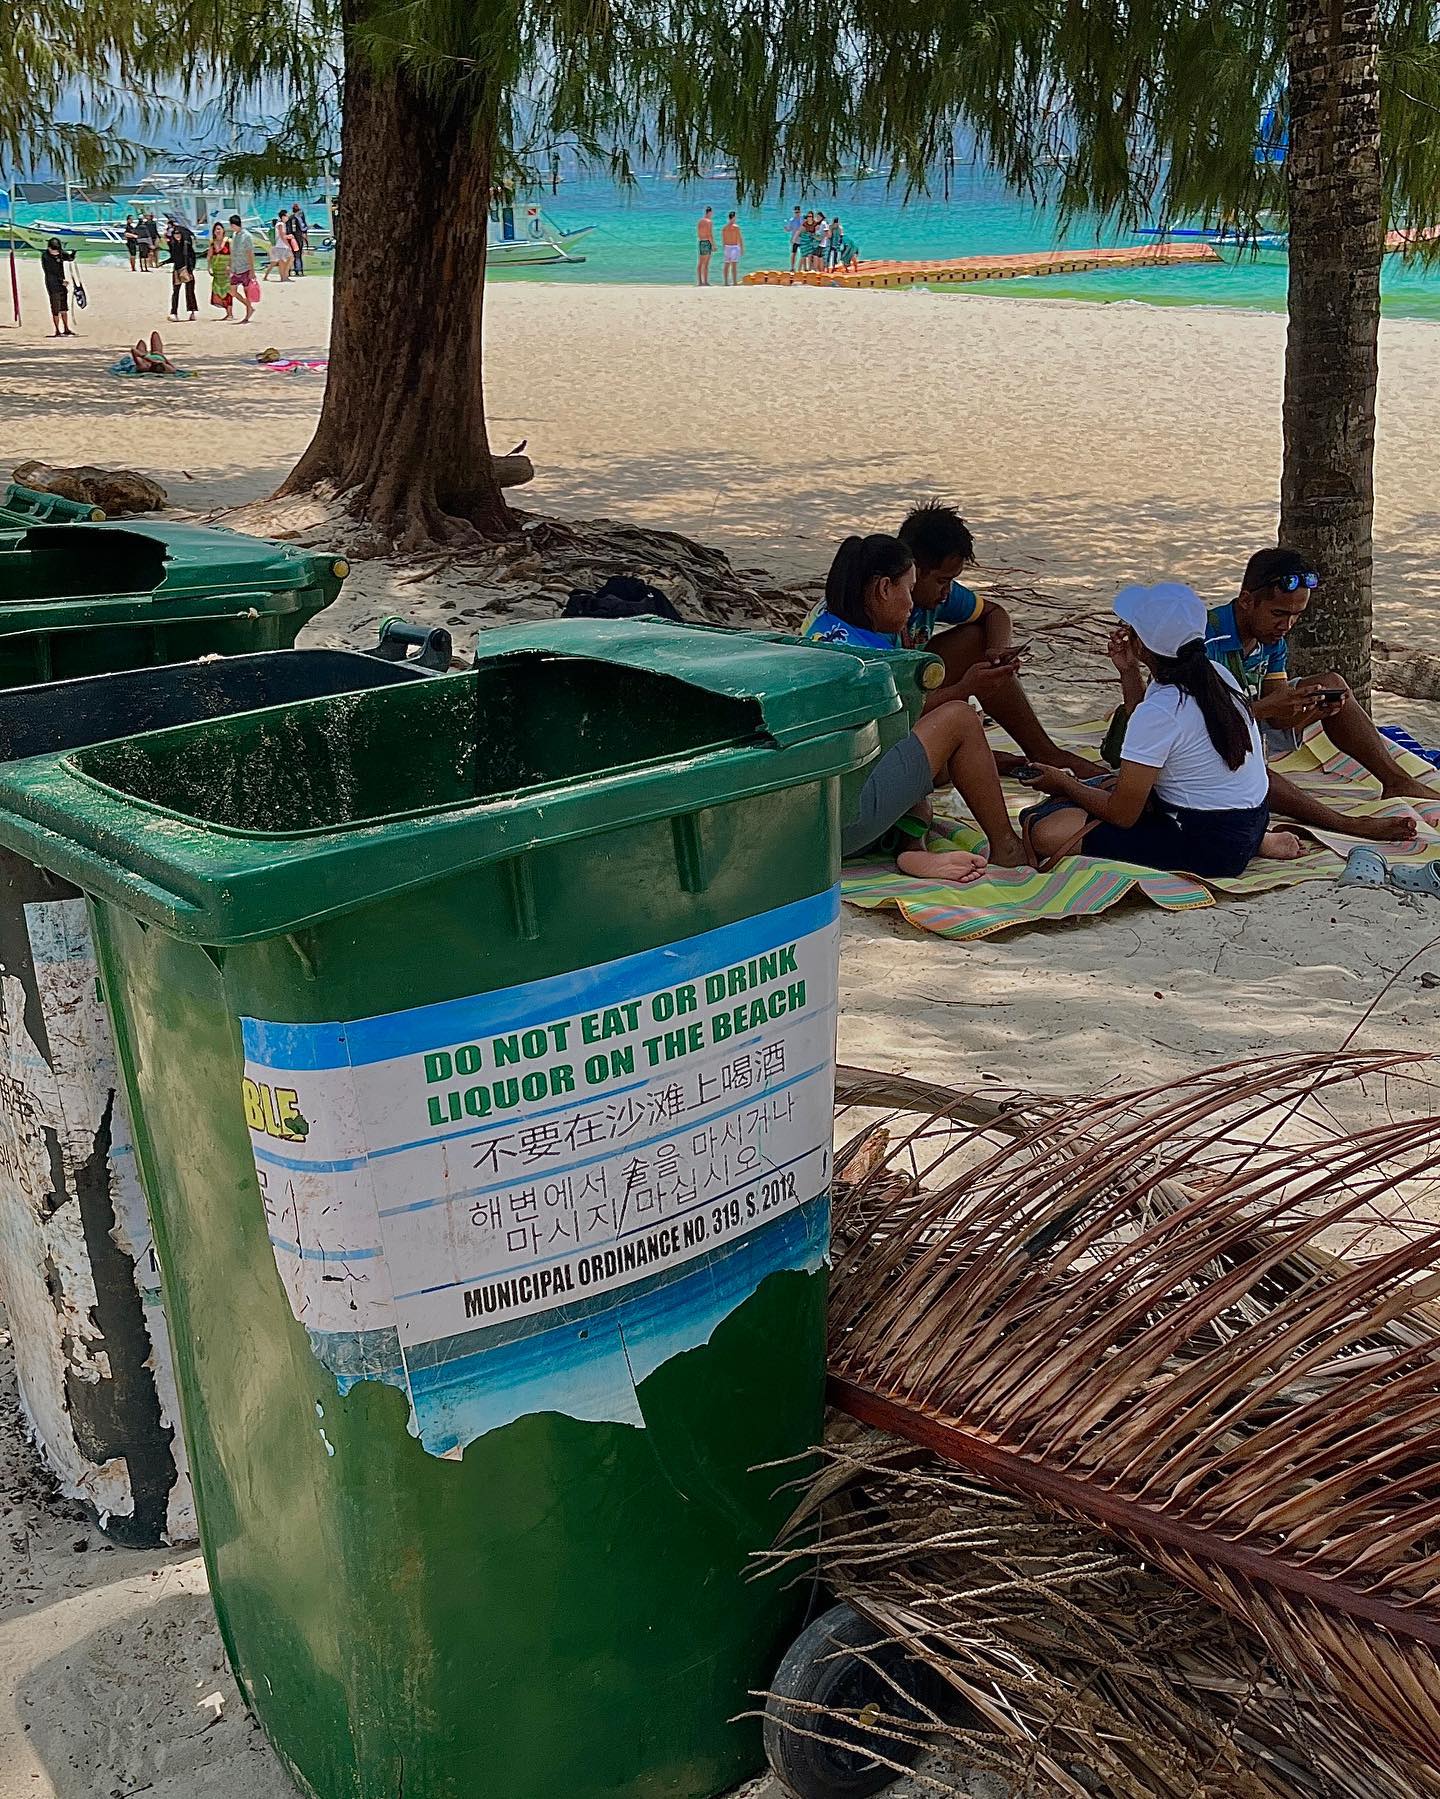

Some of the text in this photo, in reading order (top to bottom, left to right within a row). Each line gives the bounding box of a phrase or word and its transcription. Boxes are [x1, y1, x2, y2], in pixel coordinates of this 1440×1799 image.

[424, 943, 798, 1084] DO NOT EAT OR DRINK
[427, 979, 807, 1126] LIQUOR ON THE BEACH
[469, 1166, 608, 1230] 해변에서
[692, 1091, 796, 1158] 마시거나
[470, 1039, 785, 1173] 不要在沙滩上喝酒
[463, 1171, 796, 1318] MUNICIPAL ORDINANCE NO. 319, S. 2012
[507, 1146, 762, 1255] 마시지 마십시오
